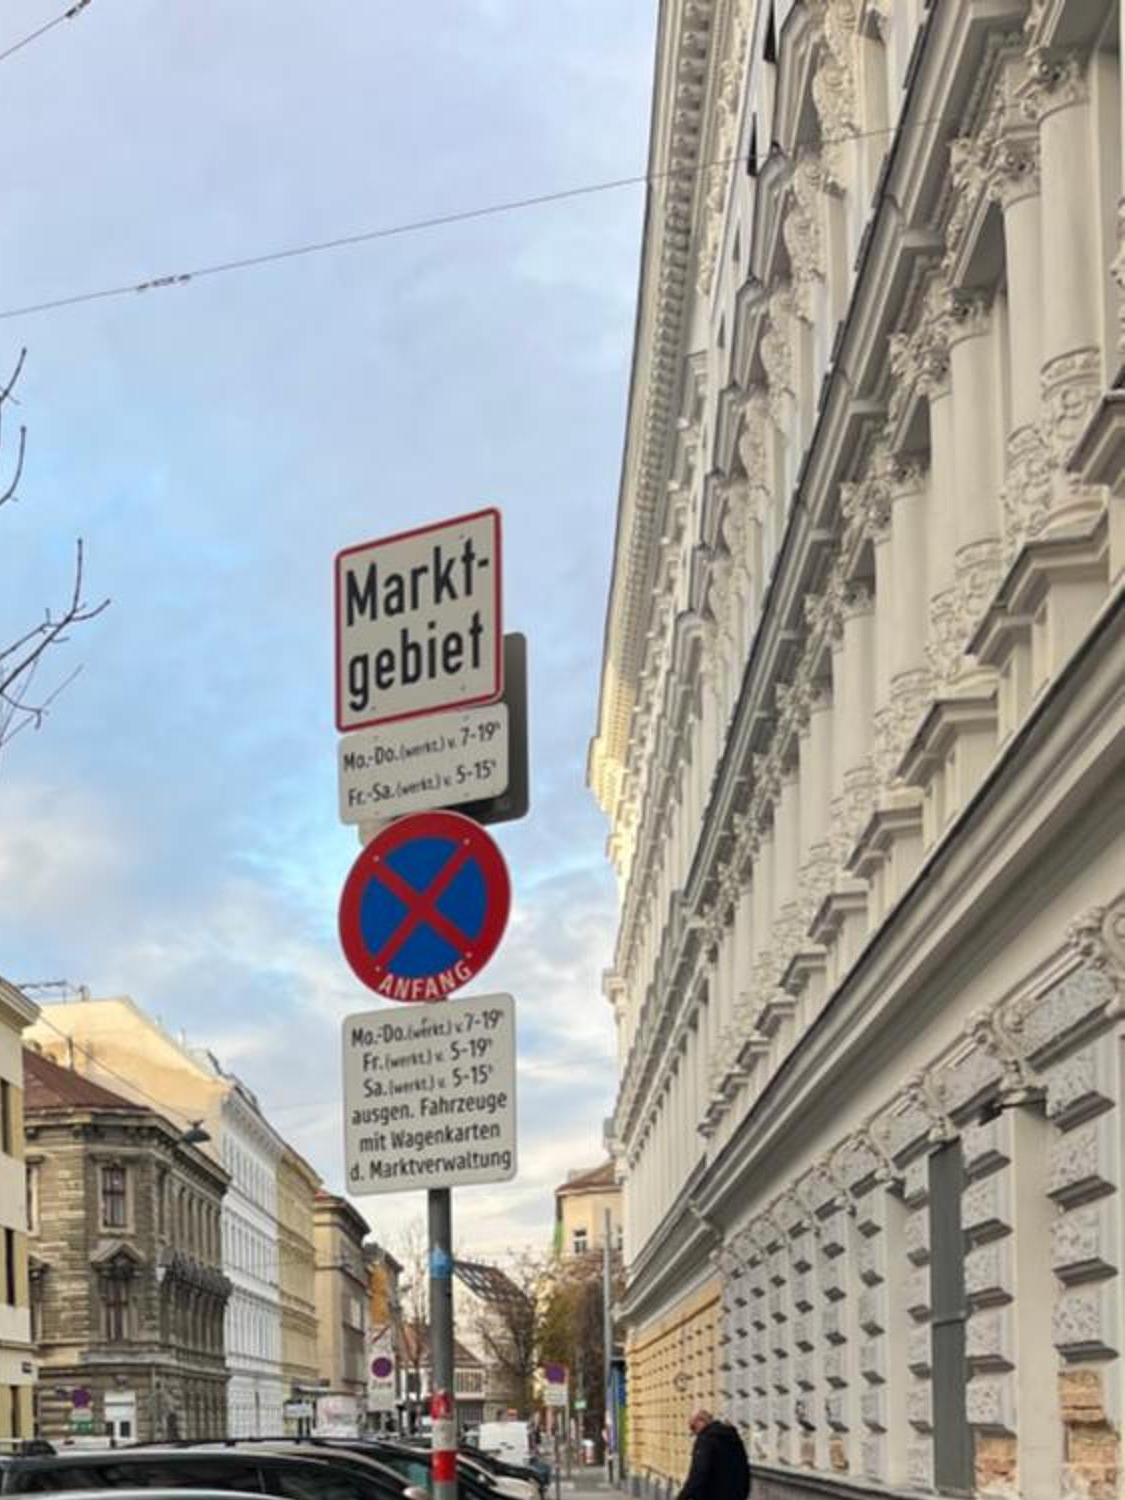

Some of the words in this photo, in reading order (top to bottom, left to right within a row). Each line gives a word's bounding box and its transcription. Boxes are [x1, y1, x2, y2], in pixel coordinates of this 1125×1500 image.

[346, 538, 489, 627] Markt-
[348, 611, 483, 712] gebiet
[378, 960, 473, 999] ANFANG
[363, 1052, 384, 1072] Fr.
[363, 1078, 388, 1098] Sa.
[352, 1104, 415, 1126] ausgen.
[420, 1091, 508, 1117] Fahrzeuge
[360, 1131, 386, 1152] mit
[390, 1123, 501, 1151] Wagenkarten
[350, 1163, 365, 1182] d.
[370, 1150, 512, 1180] Marktverwaltung
